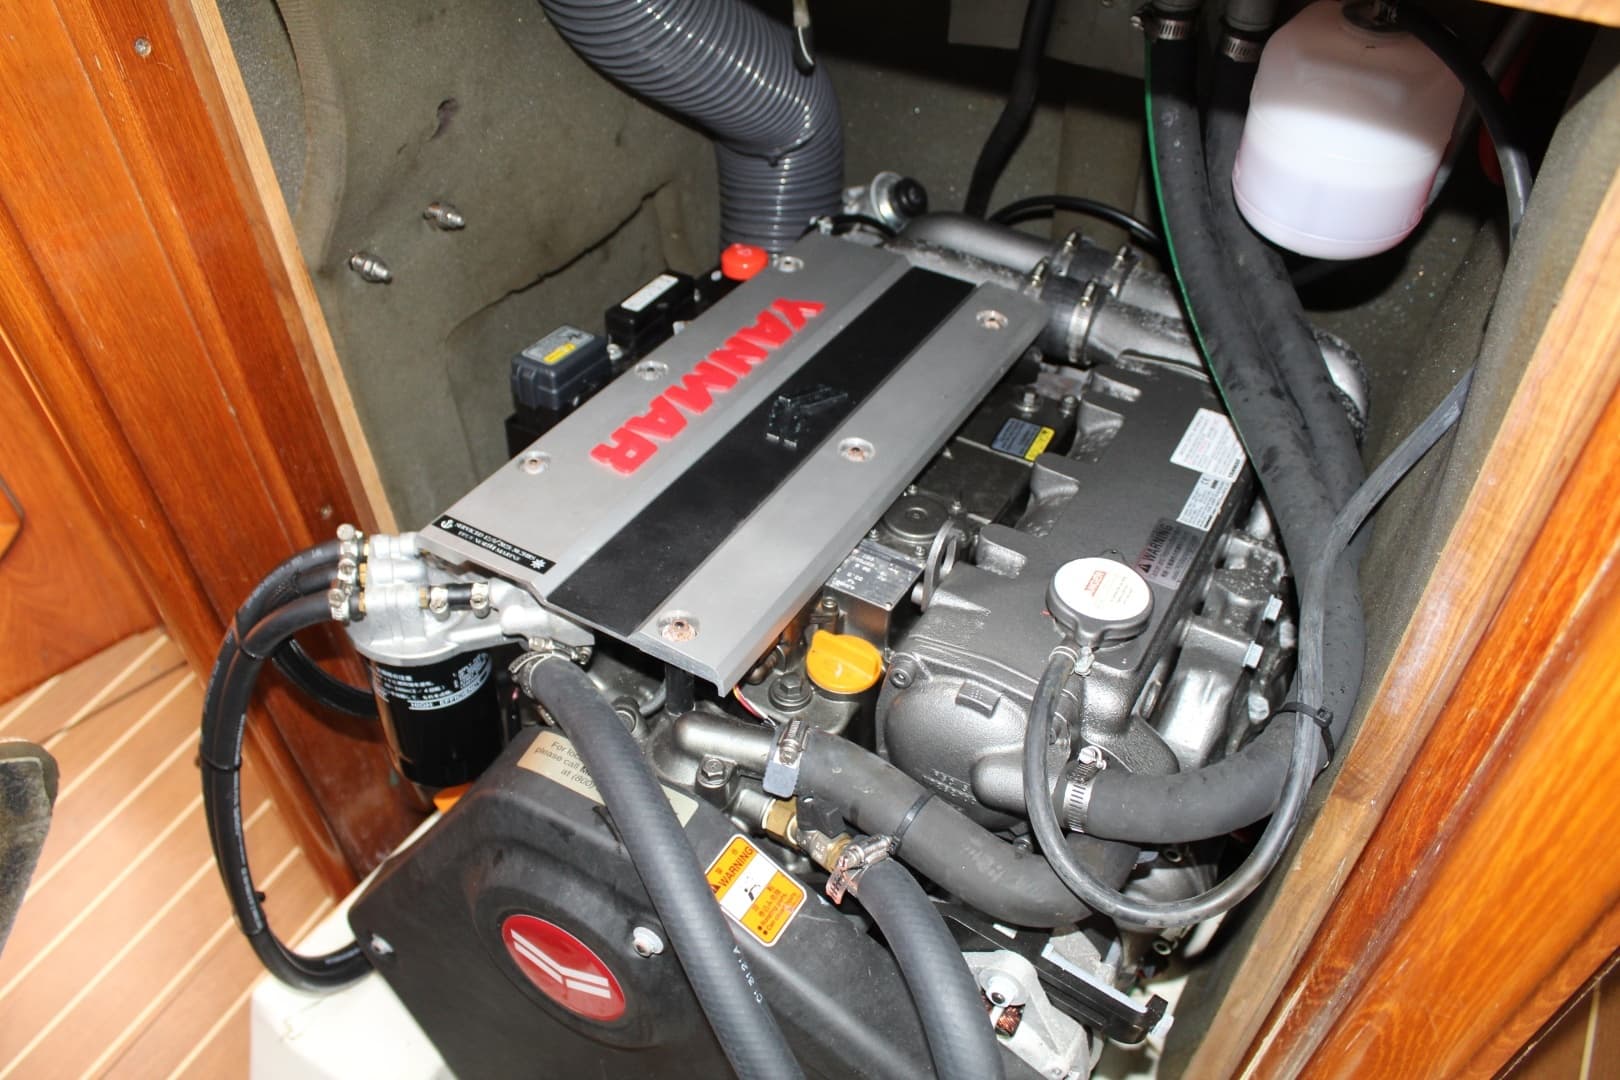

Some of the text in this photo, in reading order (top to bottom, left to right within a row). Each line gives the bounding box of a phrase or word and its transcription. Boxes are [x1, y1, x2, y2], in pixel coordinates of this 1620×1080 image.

[589, 297, 827, 475] YANMAR
[1143, 523, 1174, 561] WARNING
[534, 746, 580, 770] please call
[551, 741, 566, 752] For
[560, 769, 571, 777] at
[719, 846, 754, 887] WARNING
